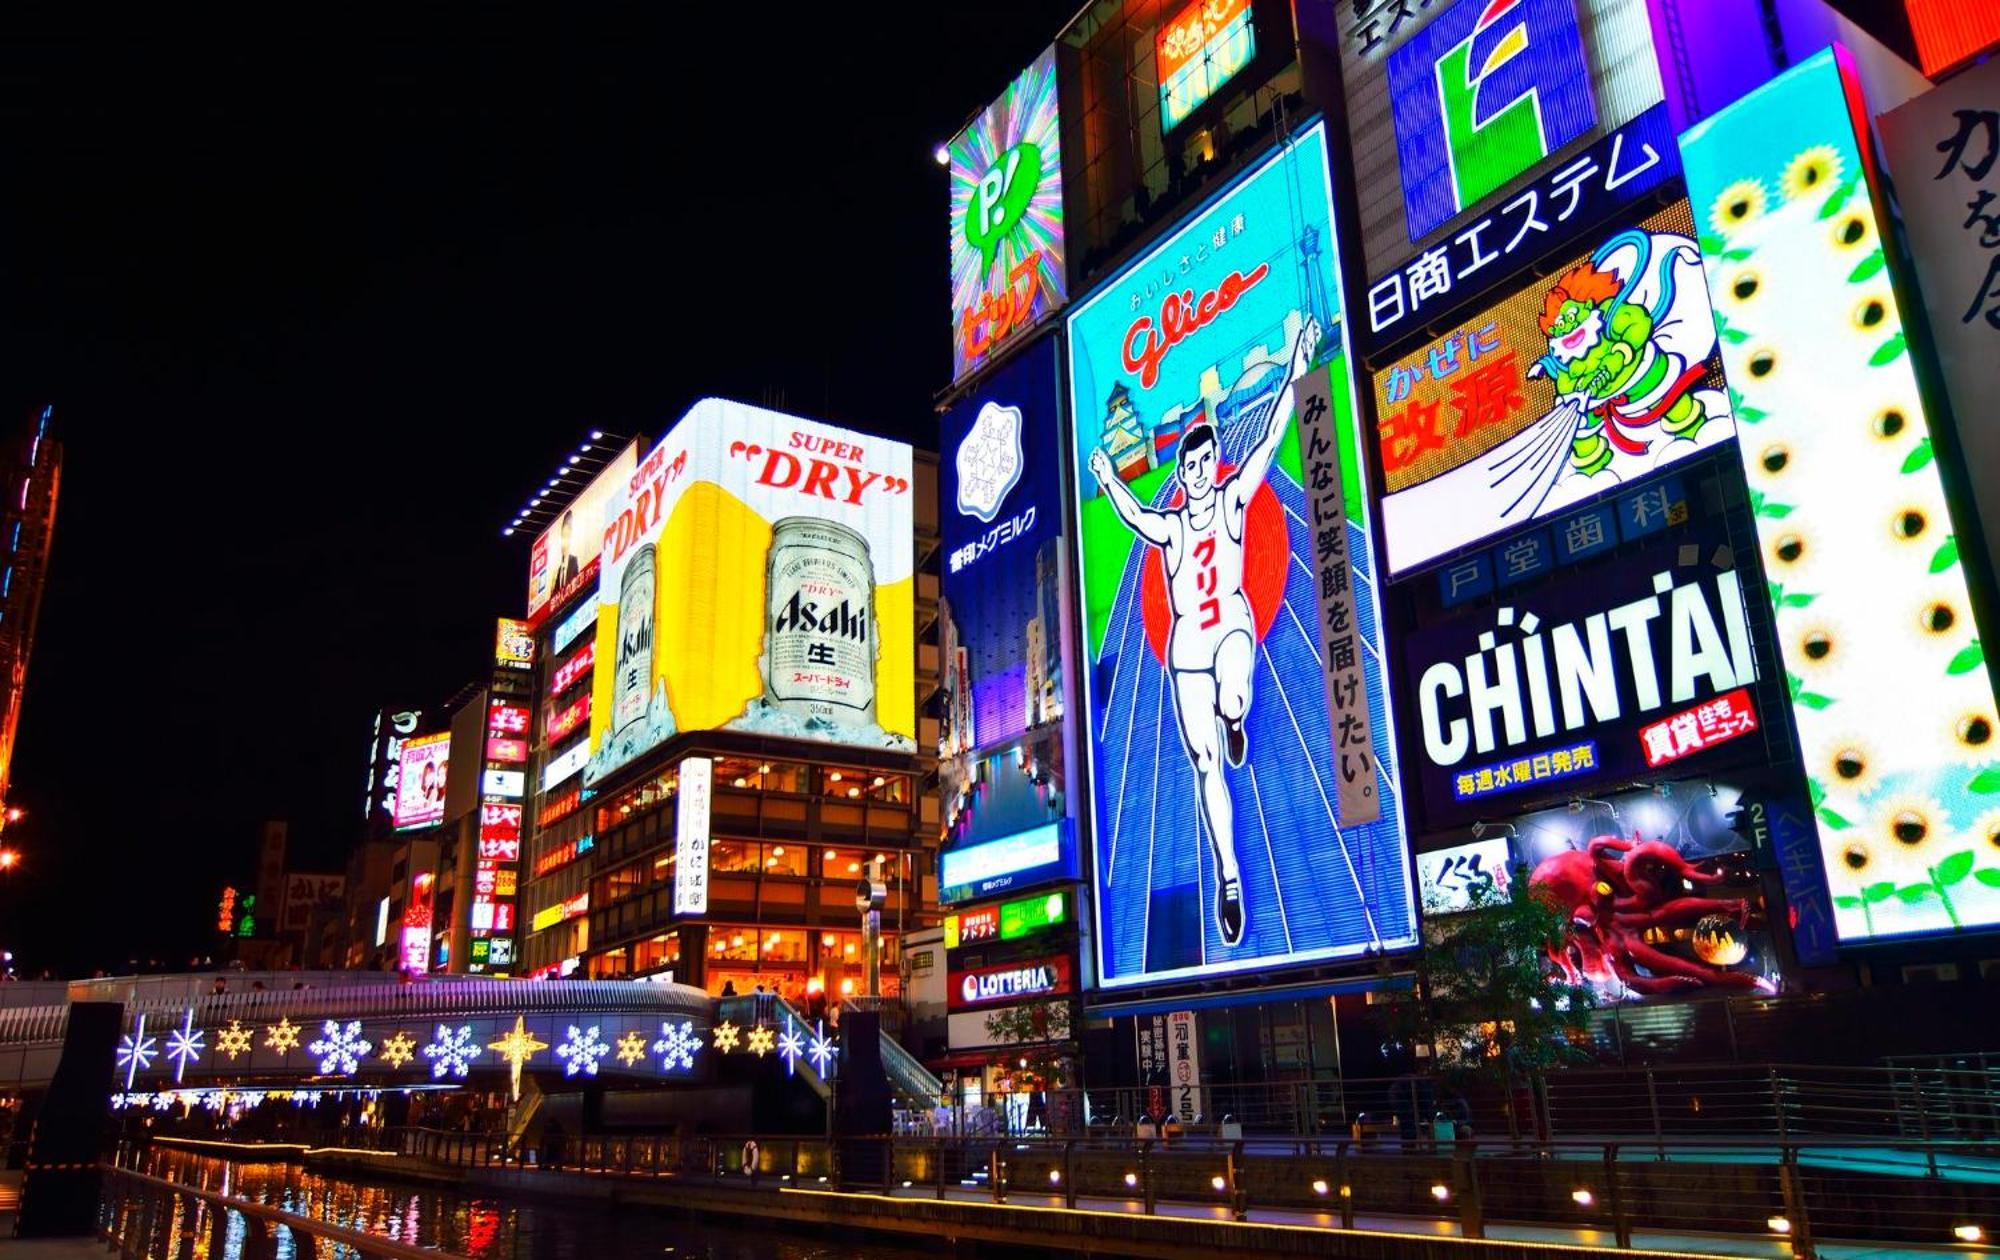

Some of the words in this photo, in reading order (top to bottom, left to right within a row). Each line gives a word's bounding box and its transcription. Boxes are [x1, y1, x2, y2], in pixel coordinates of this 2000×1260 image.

[1130, 212, 1246, 312] おいしさと健康
[1368, 133, 1660, 333] 日商エステム
[1122, 261, 1269, 390] Glico
[1384, 320, 1501, 404] かぜに
[1378, 348, 1525, 473] 改源
[629, 446, 665, 499] SUPER
[788, 431, 864, 463] SUPER
[949, 506, 1036, 574] 雪印メグミルク
[1193, 530, 1221, 630] グリコ
[1303, 394, 1372, 797] みんなに笑顔を届けたい。
[775, 590, 866, 643] Asahi
[627, 667, 638, 691] 生
[808, 642, 836, 666] 生
[1644, 711, 1704, 764] 賃貸
[1456, 745, 1594, 795] 毎週水曜日発売
[979, 966, 1048, 996] LOTTERIA
